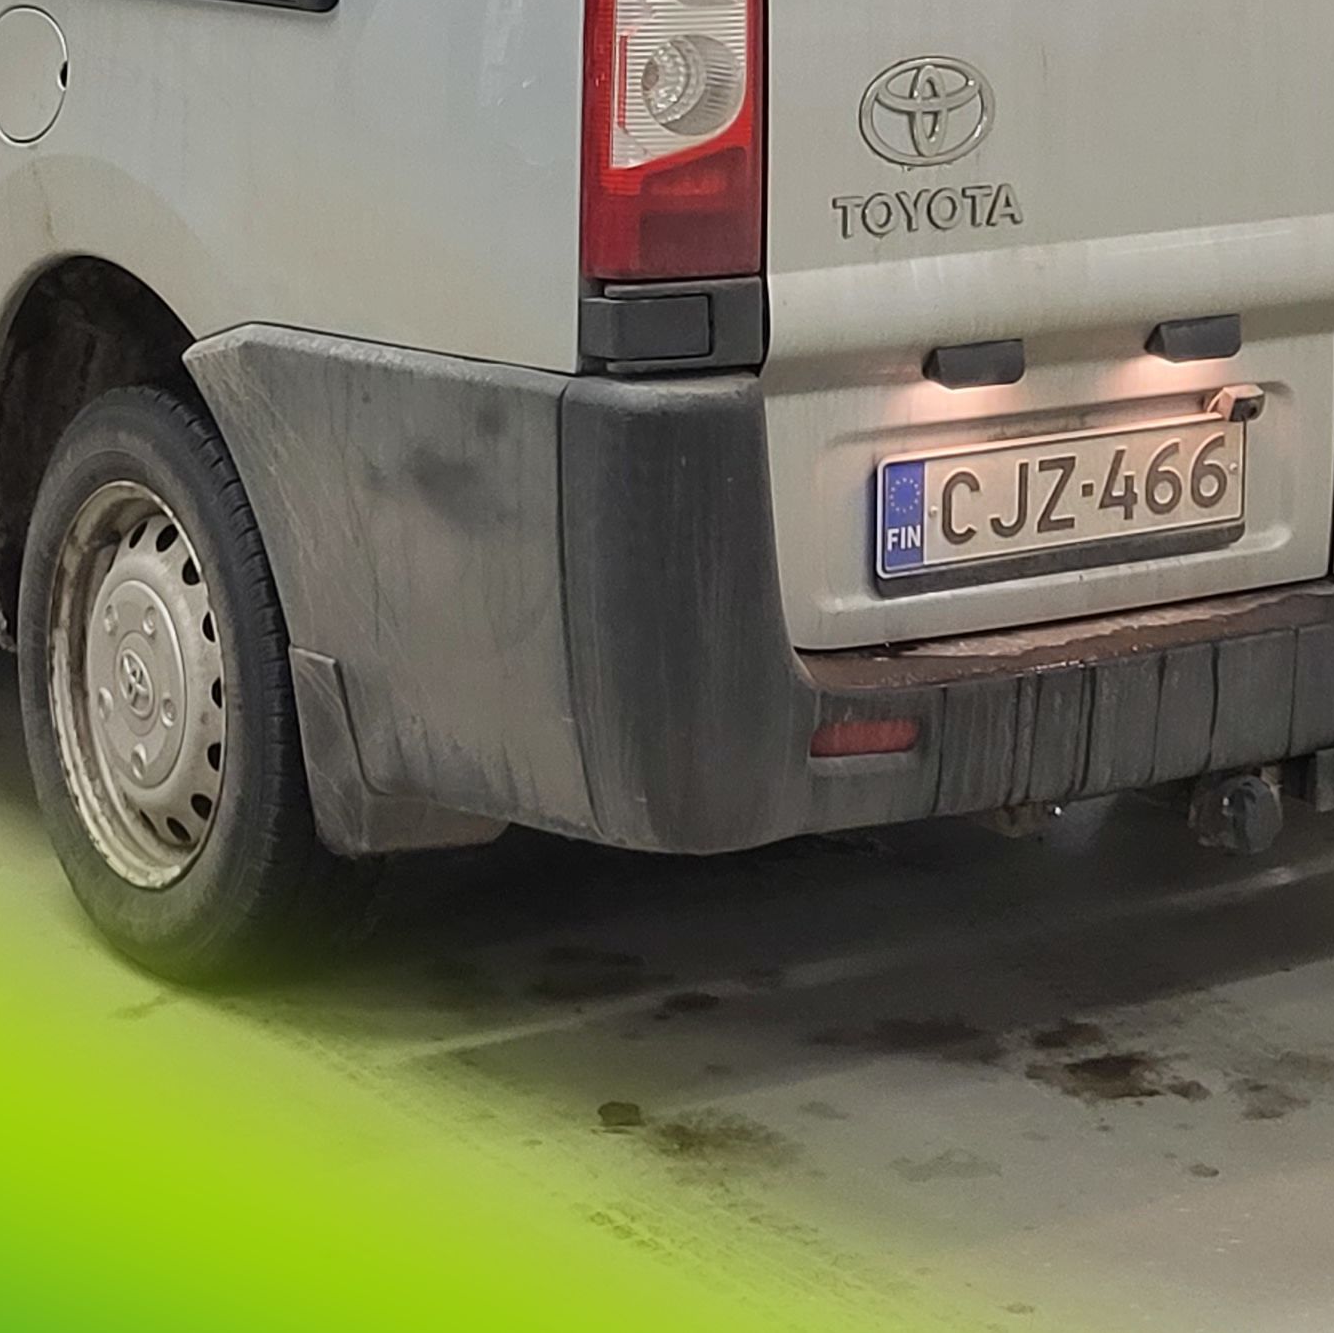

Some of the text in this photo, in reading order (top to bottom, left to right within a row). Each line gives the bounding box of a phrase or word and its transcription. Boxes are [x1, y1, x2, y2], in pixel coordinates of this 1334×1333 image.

[831, 182, 1024, 240] TOYOTA
[939, 431, 1230, 546] CJZ-466
[886, 523, 922, 552] FIN
